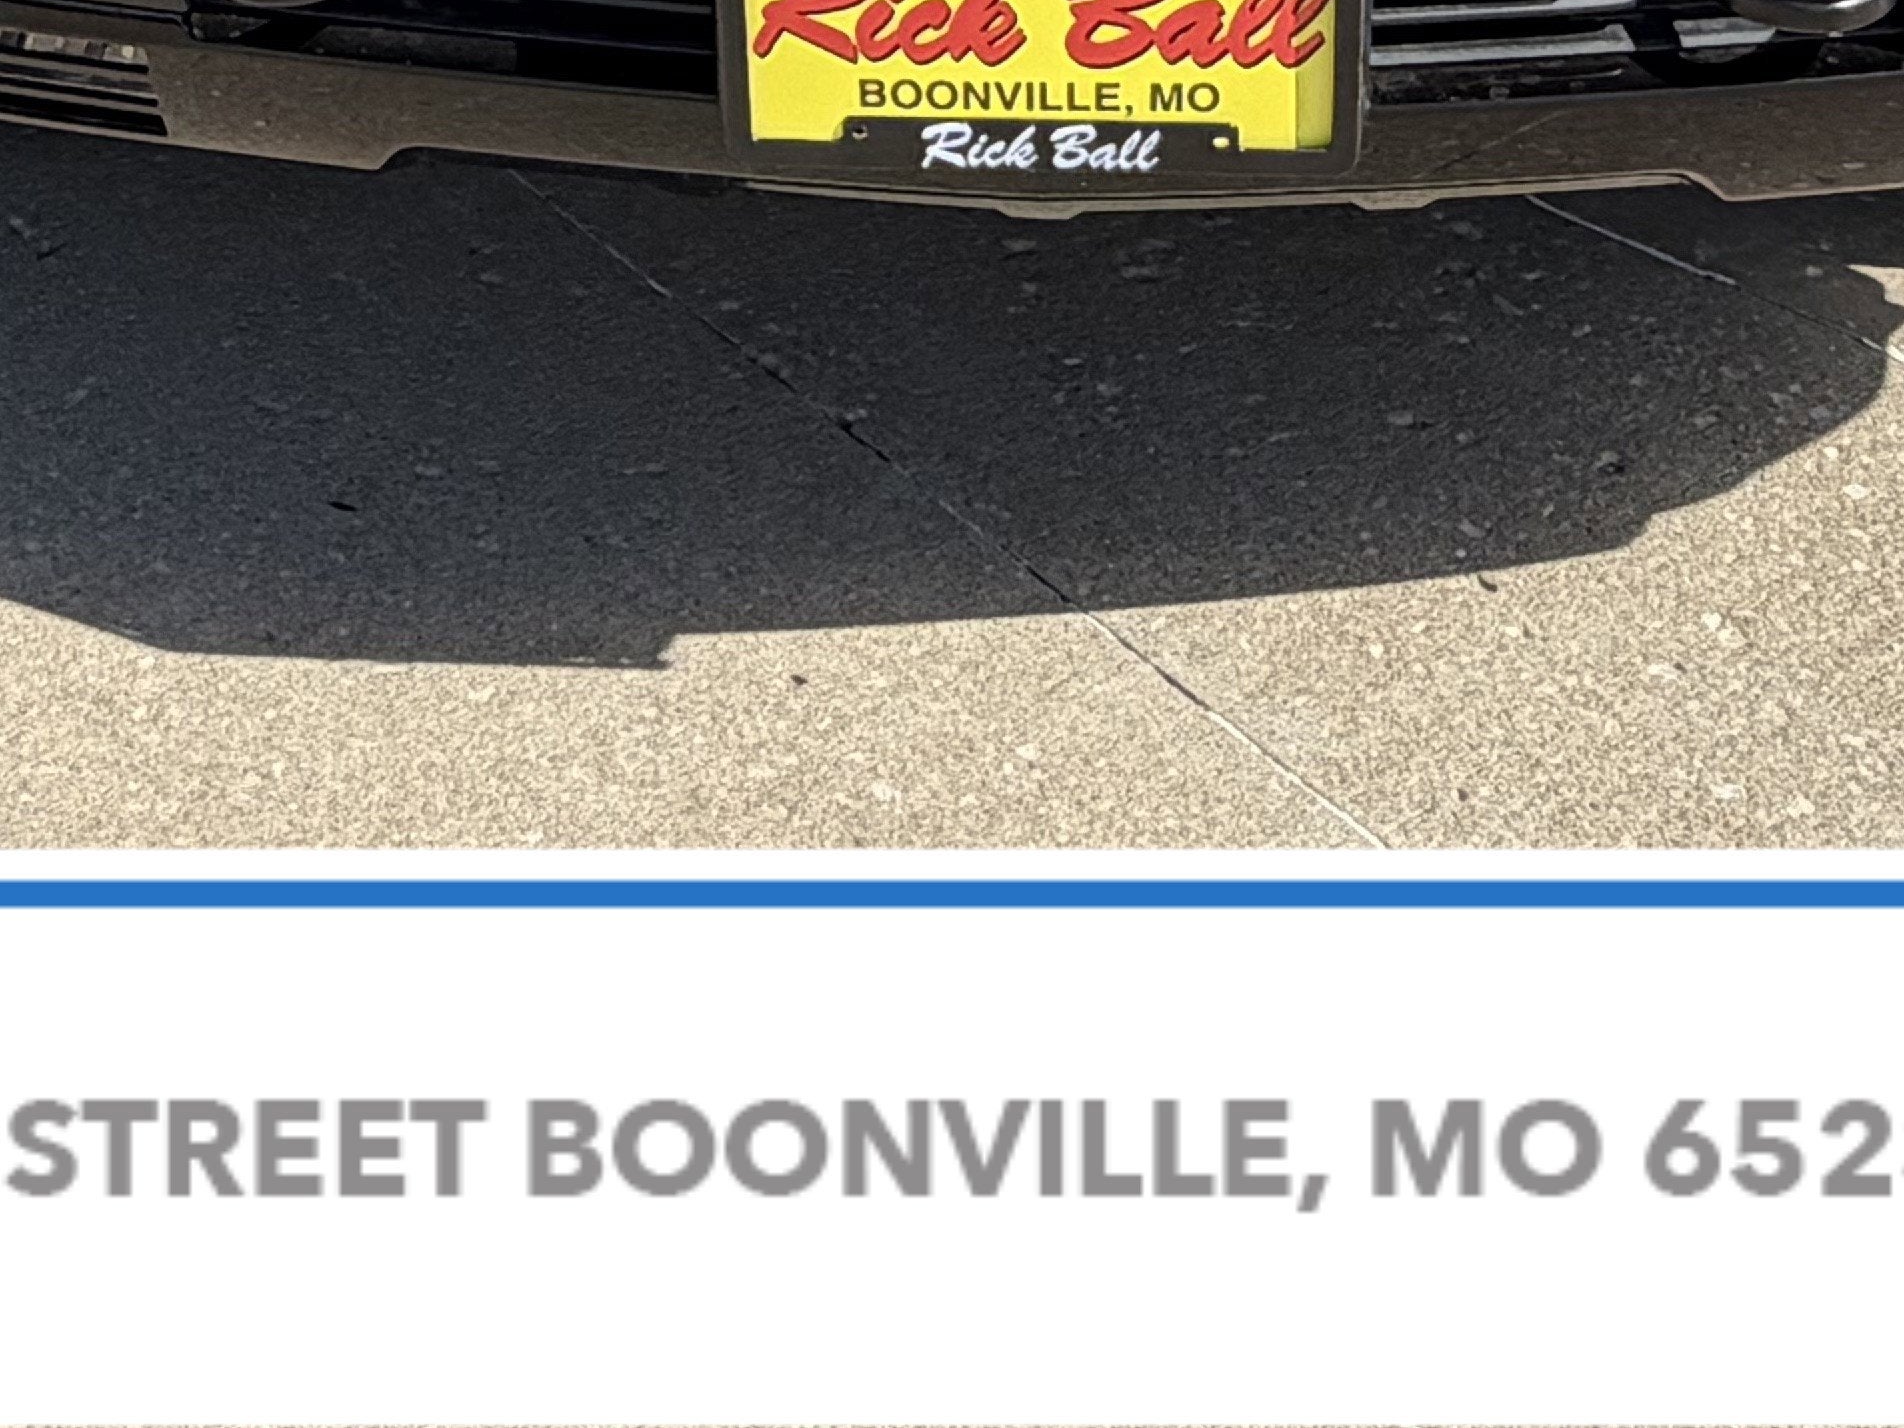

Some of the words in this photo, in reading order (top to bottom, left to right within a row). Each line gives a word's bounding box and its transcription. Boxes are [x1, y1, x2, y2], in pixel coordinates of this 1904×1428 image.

[858, 78, 1135, 115] BOONVILLE,
[1148, 81, 1222, 113] MO
[920, 121, 1040, 171] Rick
[1049, 123, 1161, 173] Ball
